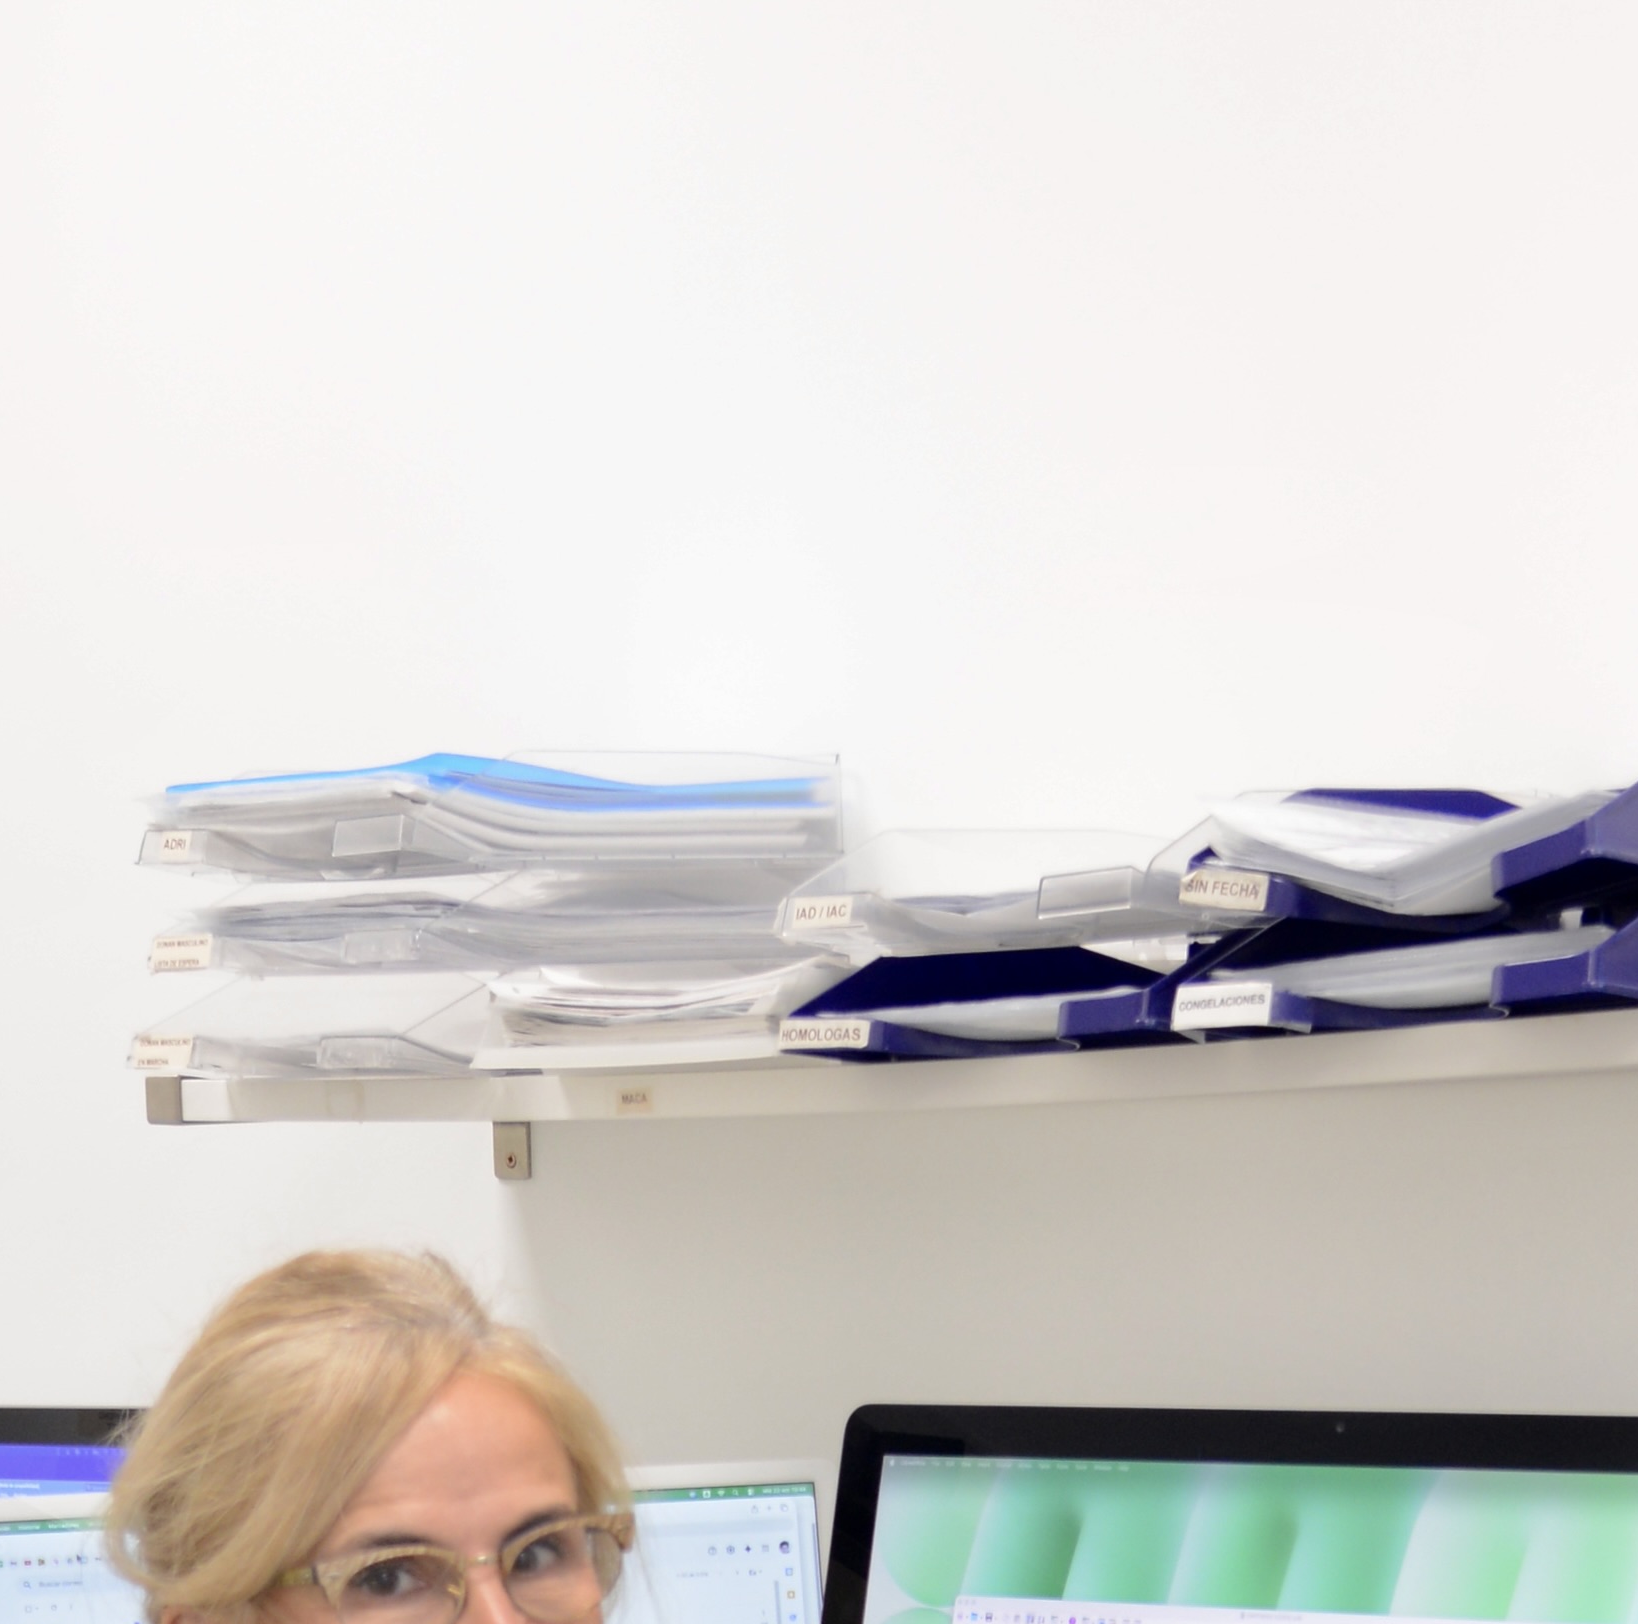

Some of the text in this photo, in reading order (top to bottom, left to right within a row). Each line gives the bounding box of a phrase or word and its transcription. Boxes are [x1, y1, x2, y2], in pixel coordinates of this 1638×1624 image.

[164, 840, 186, 850] ADRI
[1185, 879, 1260, 899] SIN FECHA
[796, 907, 816, 920] IAD
[827, 905, 847, 917] IAC
[1178, 994, 1265, 1011] CONGELACIONES
[781, 1028, 861, 1041] HOMOLOGAS
